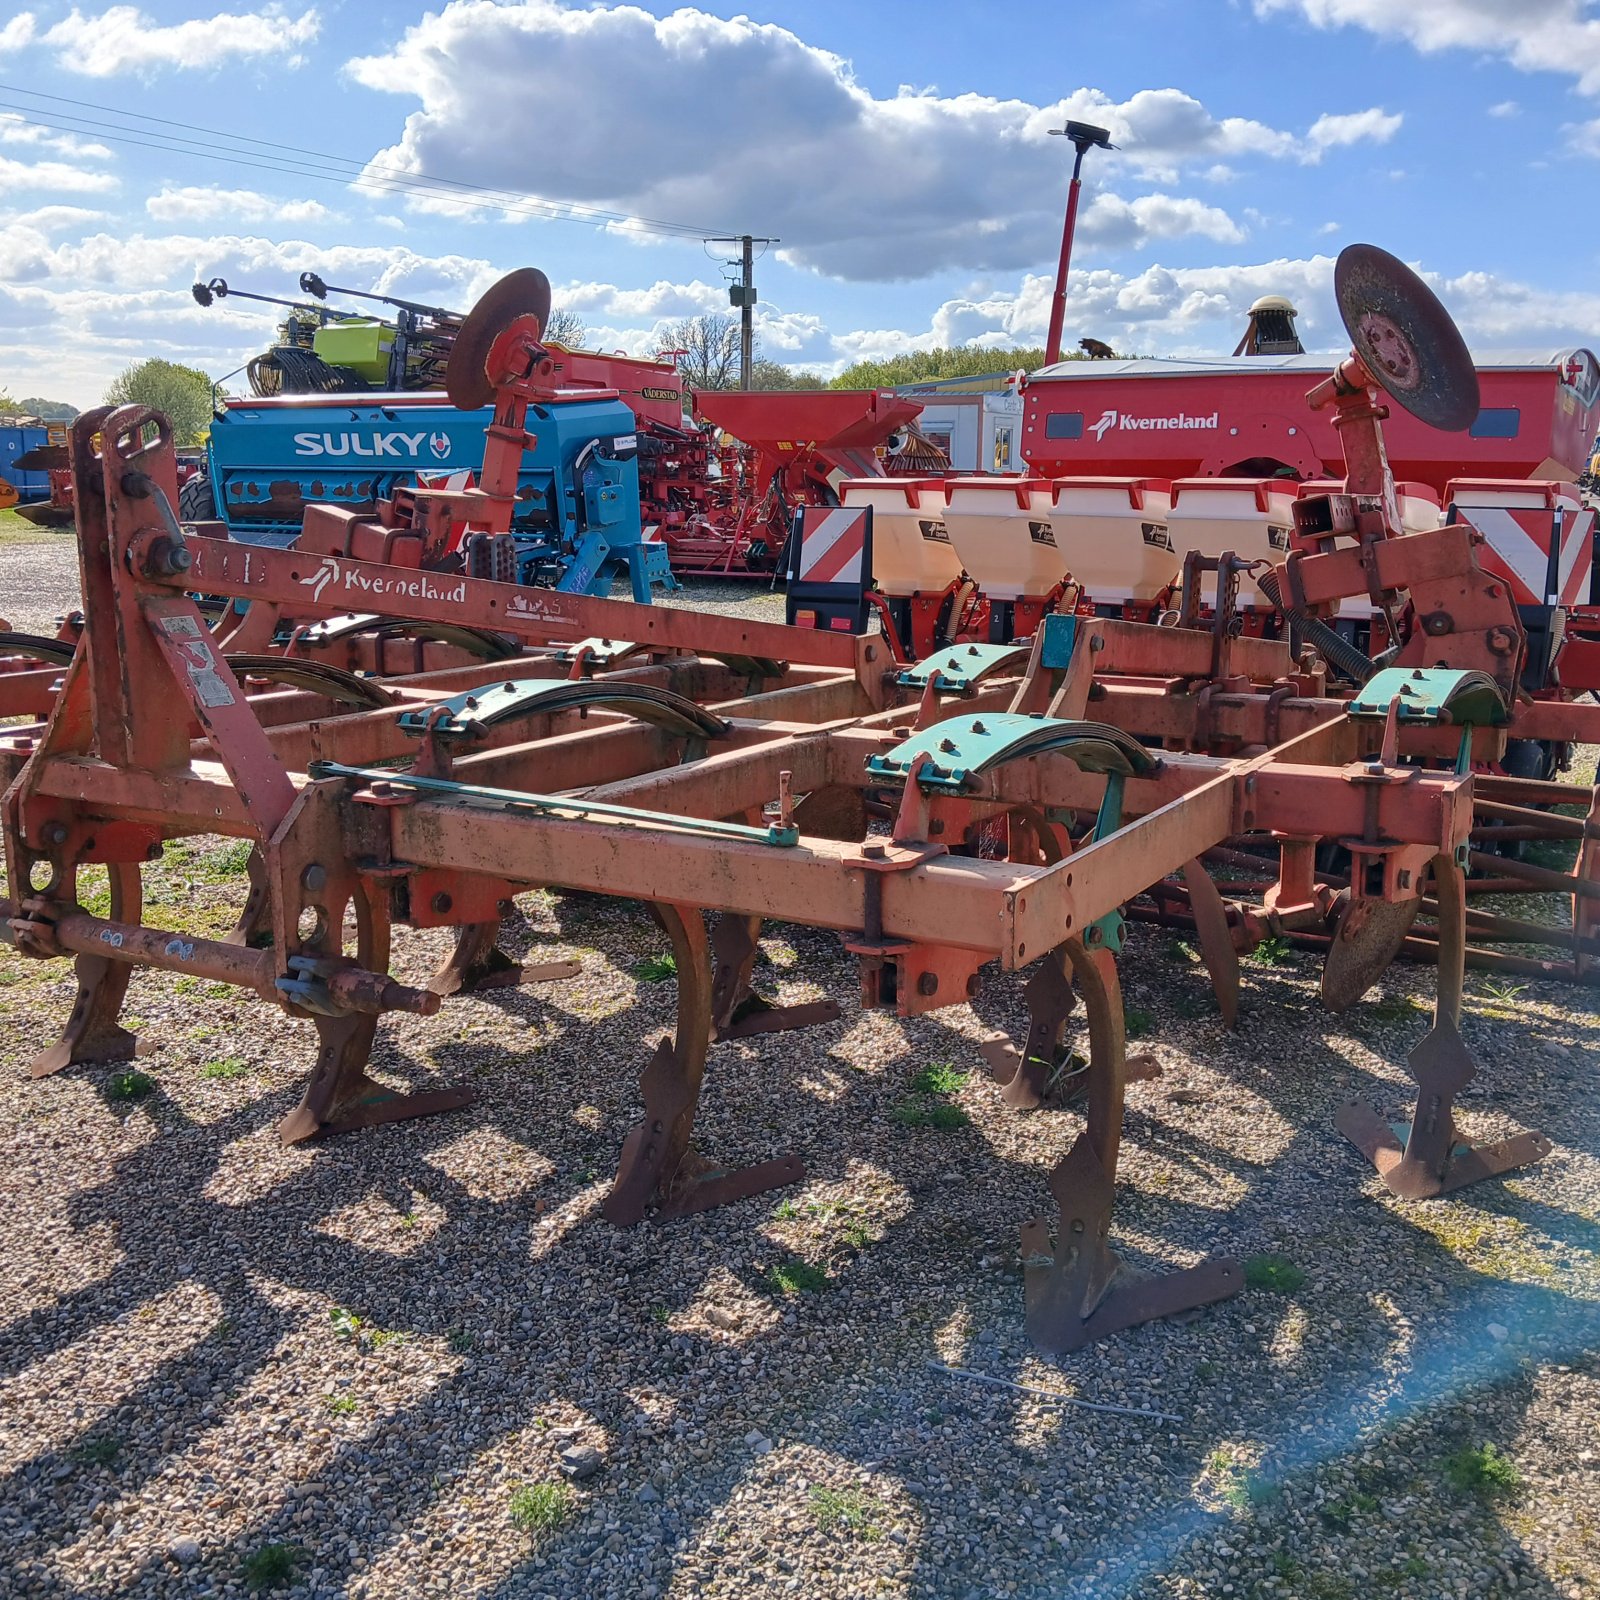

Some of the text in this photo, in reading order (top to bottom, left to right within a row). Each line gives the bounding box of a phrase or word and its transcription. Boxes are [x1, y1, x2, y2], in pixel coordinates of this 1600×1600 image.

[1119, 412, 1218, 430] Kverneland
[293, 432, 427, 456] SULKY
[994, 614, 1000, 623] 2
